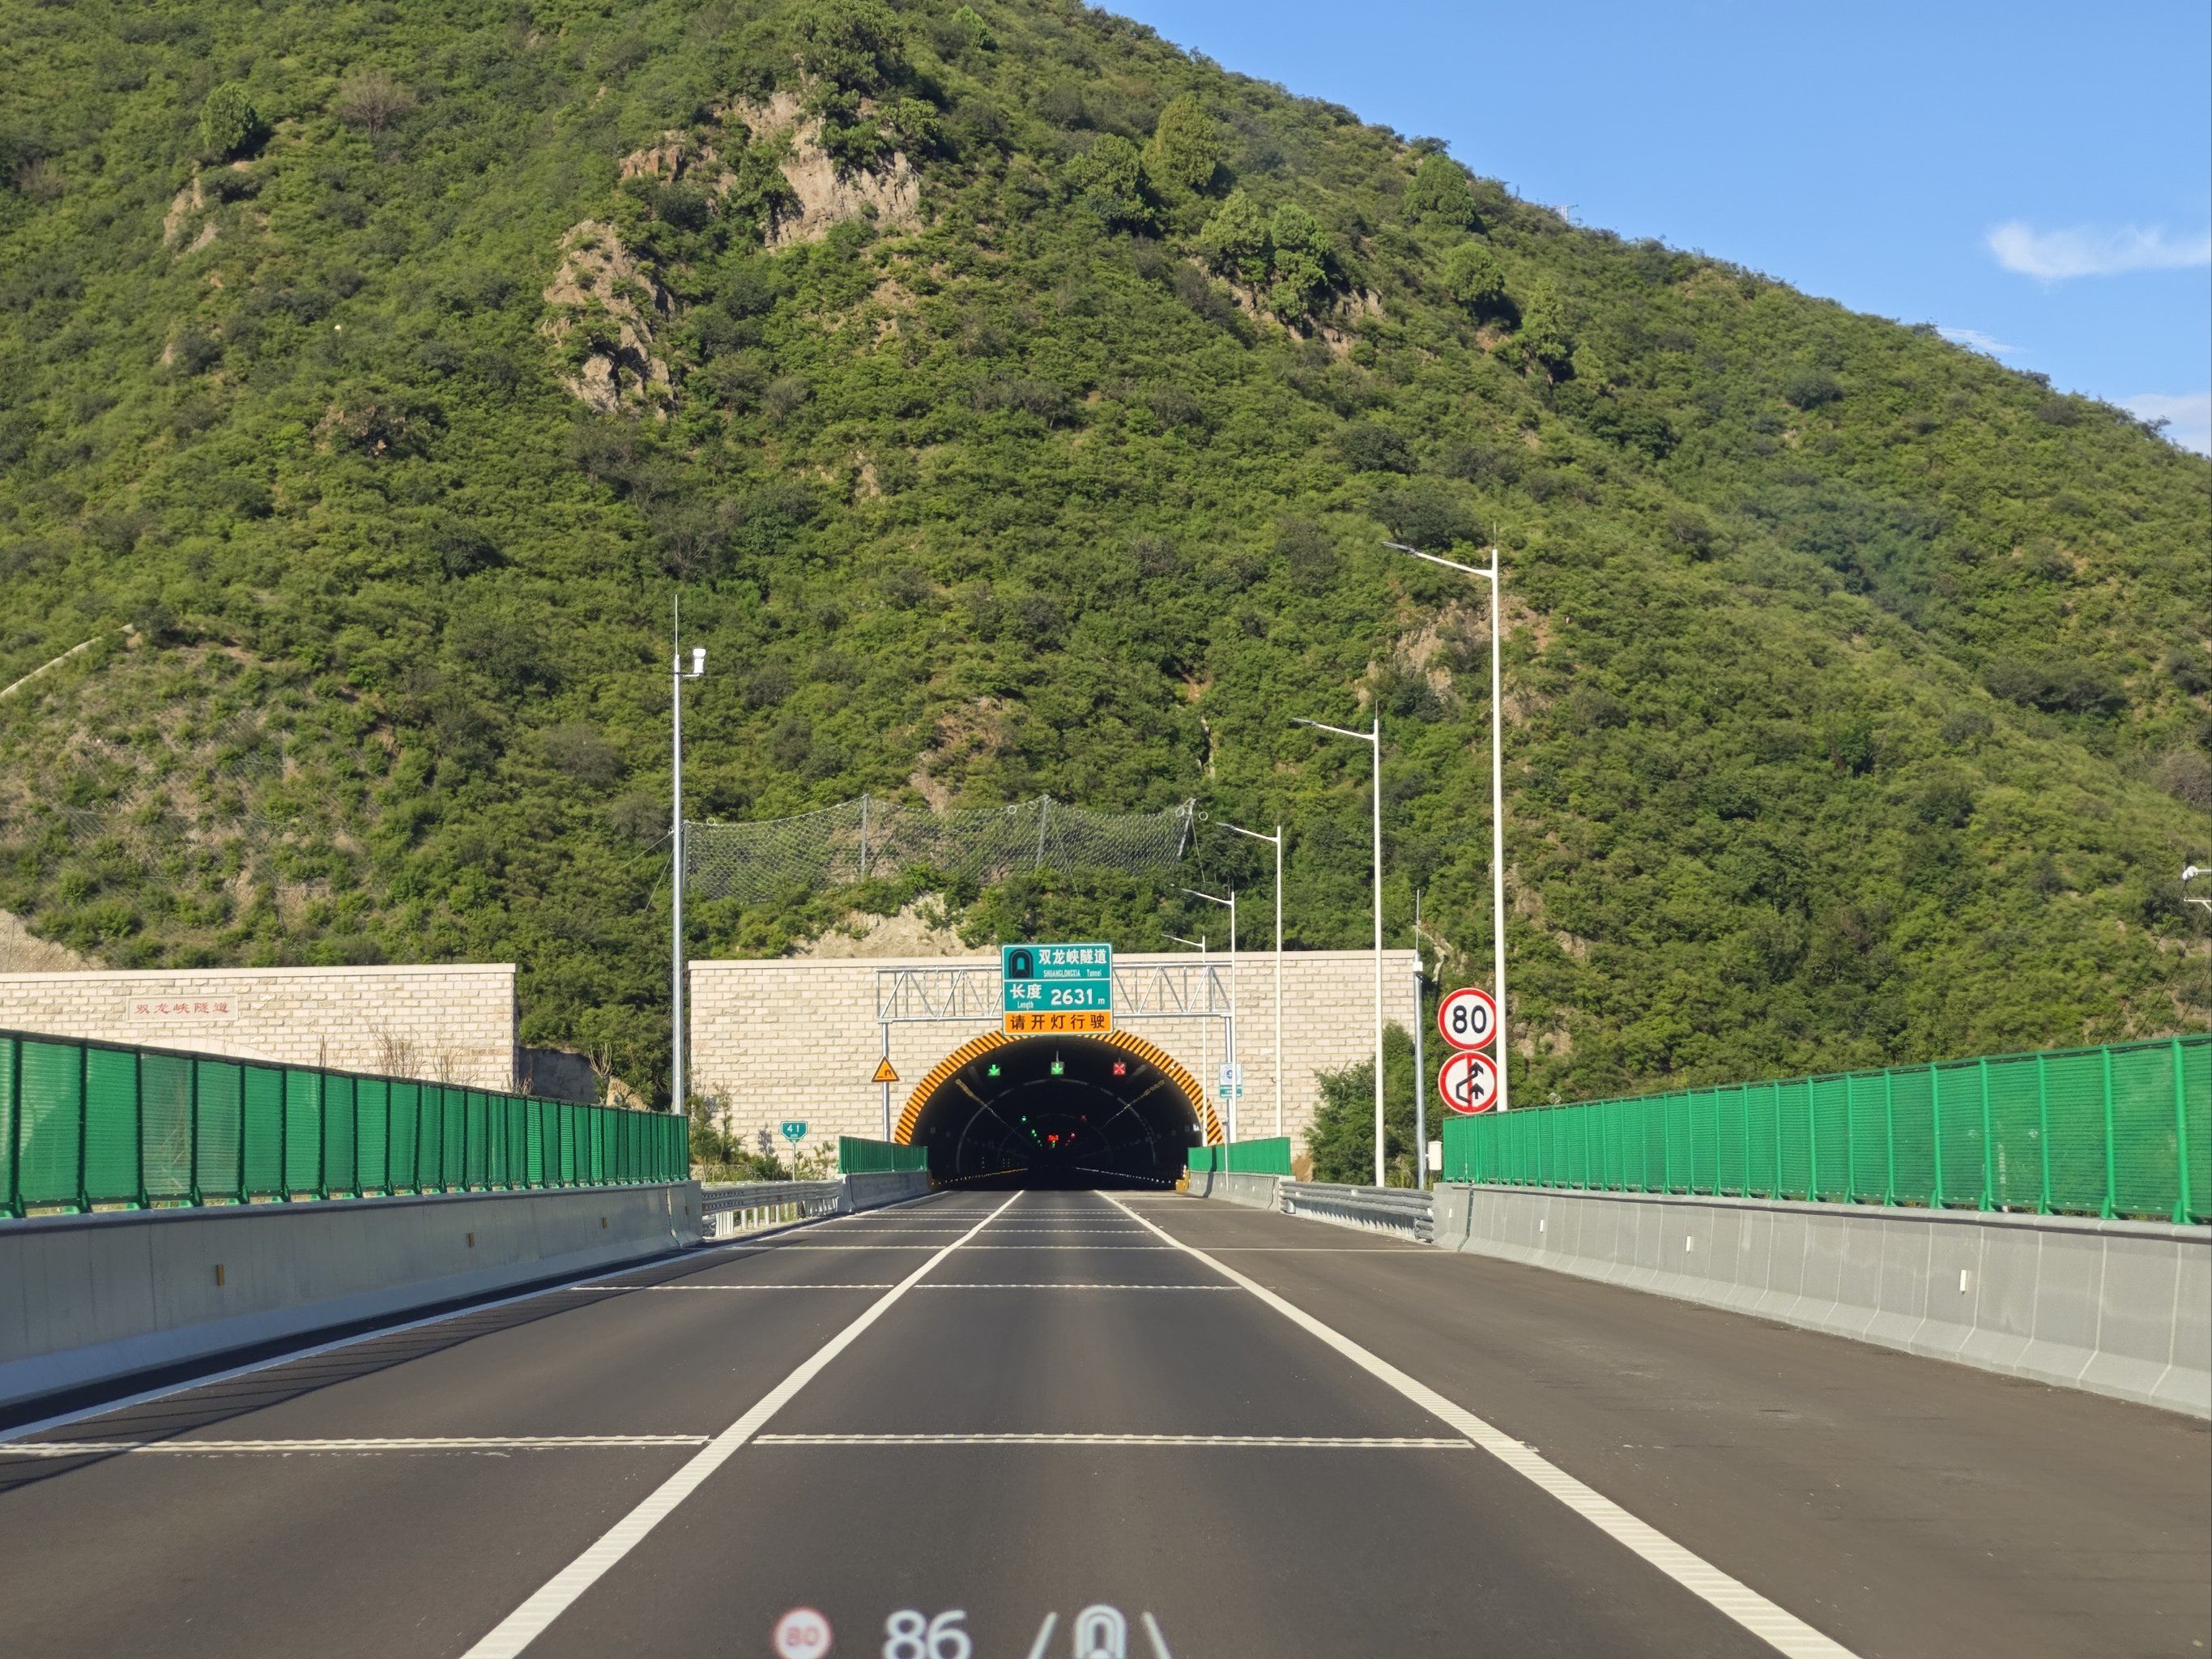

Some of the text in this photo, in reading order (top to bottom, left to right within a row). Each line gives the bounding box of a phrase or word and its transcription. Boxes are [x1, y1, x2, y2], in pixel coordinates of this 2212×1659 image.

[1038, 949, 1107, 965] 双龙峡隧道
[1087, 969, 1102, 977] Tunnel
[1009, 983, 1042, 999] 长度
[1051, 988, 1093, 1004] 2631
[1017, 1000, 1034, 1010] Length
[1010, 1014, 1105, 1030] 请开灯行驶
[1452, 1004, 1487, 1034] 80
[786, 1124, 799, 1132] 41
[882, 1610, 972, 1659] 86
